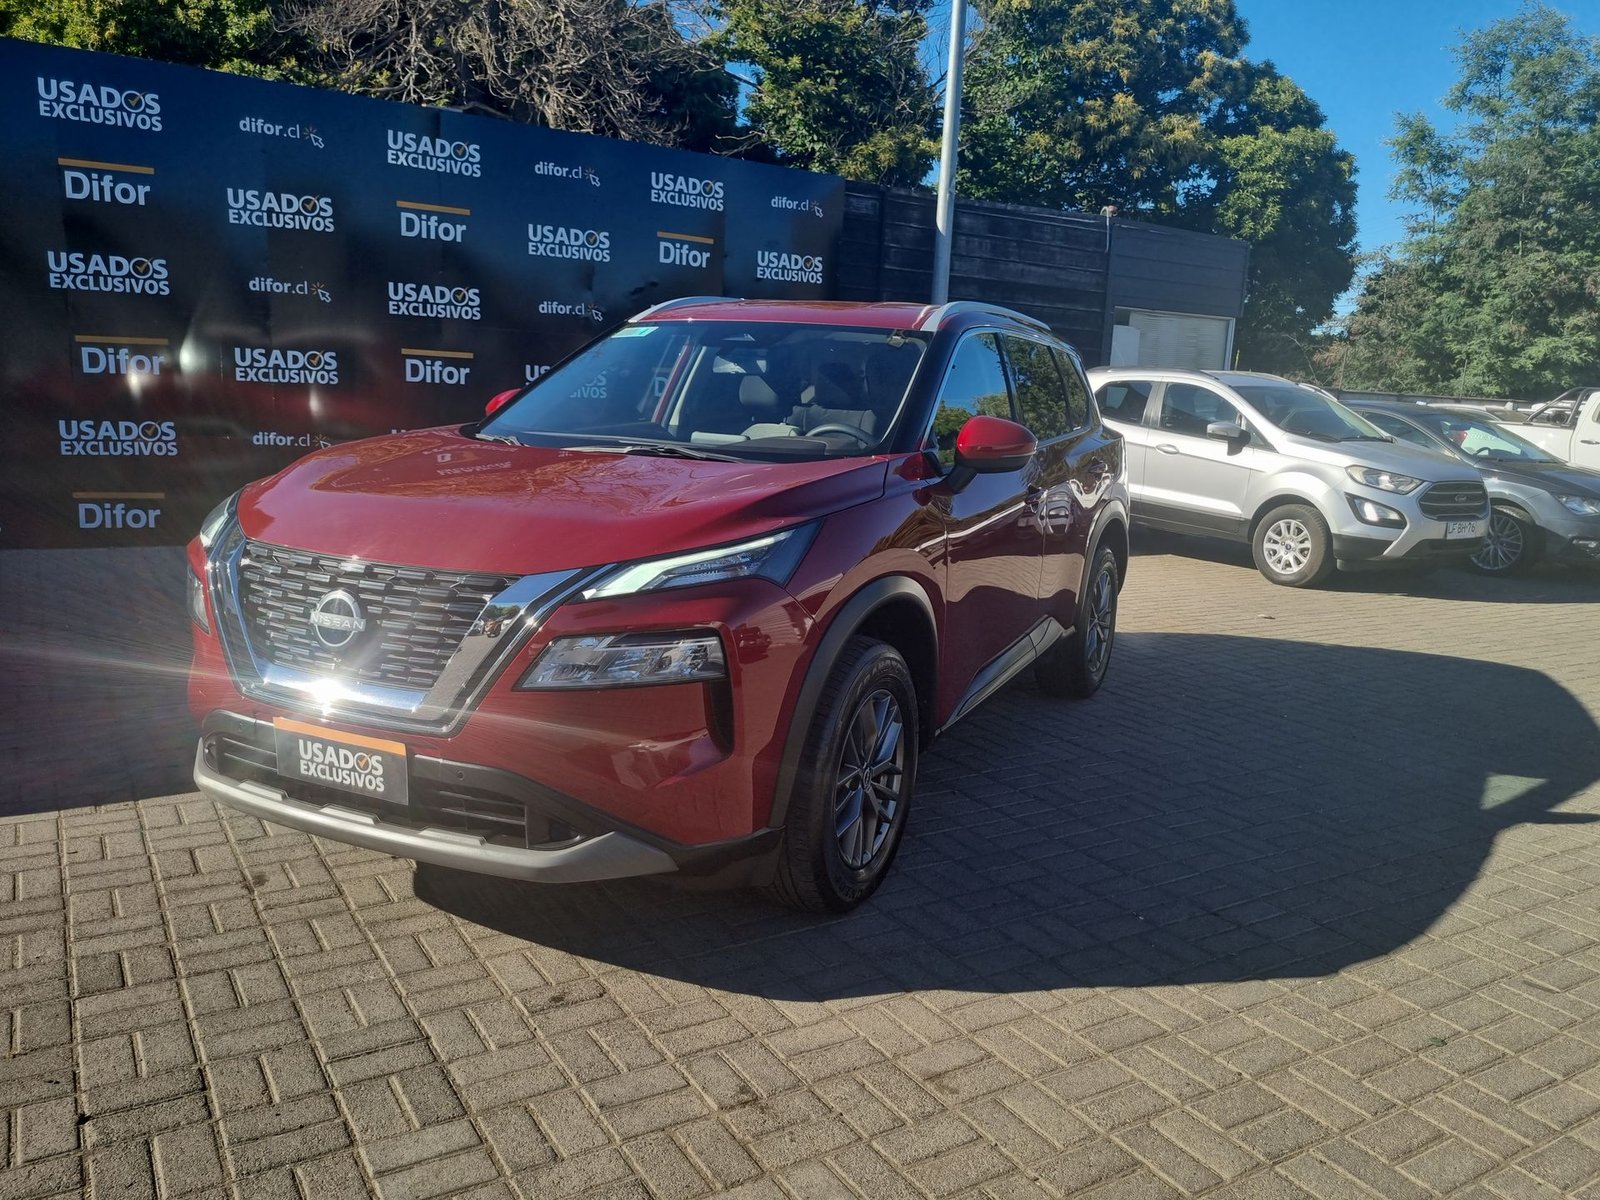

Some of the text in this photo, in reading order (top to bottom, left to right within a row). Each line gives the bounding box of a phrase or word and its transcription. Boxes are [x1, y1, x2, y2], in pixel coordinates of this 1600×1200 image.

[37, 77, 161, 115] USADOS
[38, 100, 163, 132] EXCLUSIVOS
[239, 116, 300, 139] difor.cl
[387, 129, 481, 163] USADOS
[387, 149, 481, 178] EXCLUSIVOS
[534, 161, 582, 180] difor.cl
[64, 170, 151, 206] Difor
[651, 171, 724, 199] USADOS
[226, 187, 333, 217] USADOS
[651, 189, 724, 212] EXCLUSIVOS
[771, 196, 809, 211] difor.cl
[228, 208, 335, 233] EXCLUSIVOS
[400, 211, 467, 243] Difor
[528, 223, 610, 250] USADOS
[528, 242, 611, 263] EXCLUSIVOS
[659, 241, 711, 268] Difor
[757, 250, 823, 273] USADOS
[48, 250, 169, 281] USADOS
[756, 267, 823, 284] EXCLUSIVOS
[49, 272, 170, 296] EXCLUSIVOS
[248, 276, 309, 295] difor.cl
[388, 281, 481, 307] USADOS
[388, 300, 481, 320] EXCLUSIVOS
[538, 301, 585, 316] difor.cl
[81, 346, 165, 376] Difor
[234, 347, 338, 371] USADOS
[405, 358, 470, 385] Difor
[235, 367, 339, 385] EXCLUSIVOS
[58, 420, 177, 442] USADOS
[252, 431, 310, 447] difor.cl
[60, 439, 178, 456] EXCLUSIVOS
[78, 502, 161, 529] Difor
[310, 610, 365, 630] NISSAN
[298, 739, 384, 776] USADOS
[299, 759, 385, 793] EXCLUSIVOS
